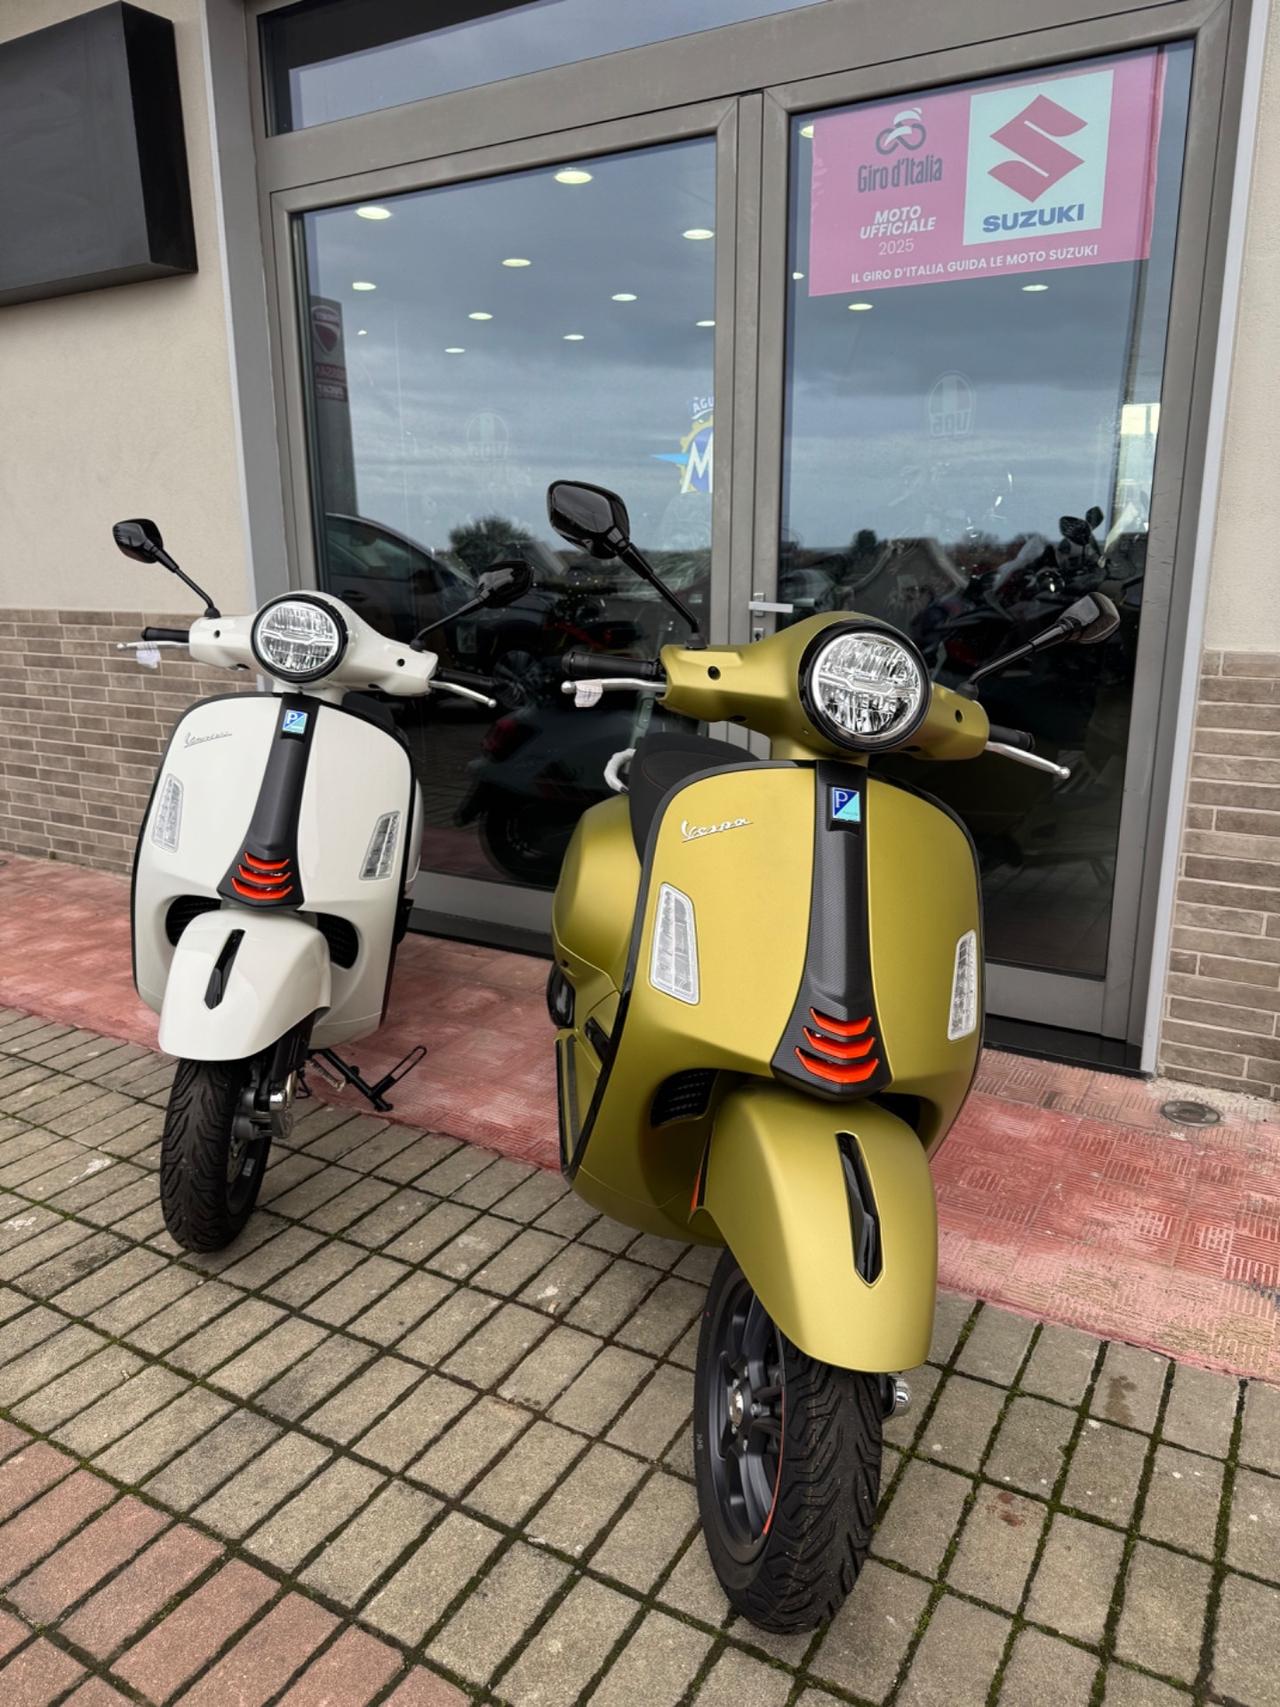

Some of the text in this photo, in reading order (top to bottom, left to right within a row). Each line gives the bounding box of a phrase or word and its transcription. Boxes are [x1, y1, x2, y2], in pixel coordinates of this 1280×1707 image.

[857, 154, 943, 193] Giro d'Italia
[860, 216, 937, 240] UFFICIALE
[874, 205, 922, 225] MOTO
[982, 203, 1085, 233] SUZUKI
[877, 238, 914, 256] 2025
[851, 244, 1098, 284] IL GIRO D'ITALIA GUIDA LE MOTO SUZUKI
[681, 817, 754, 843] Vespa
